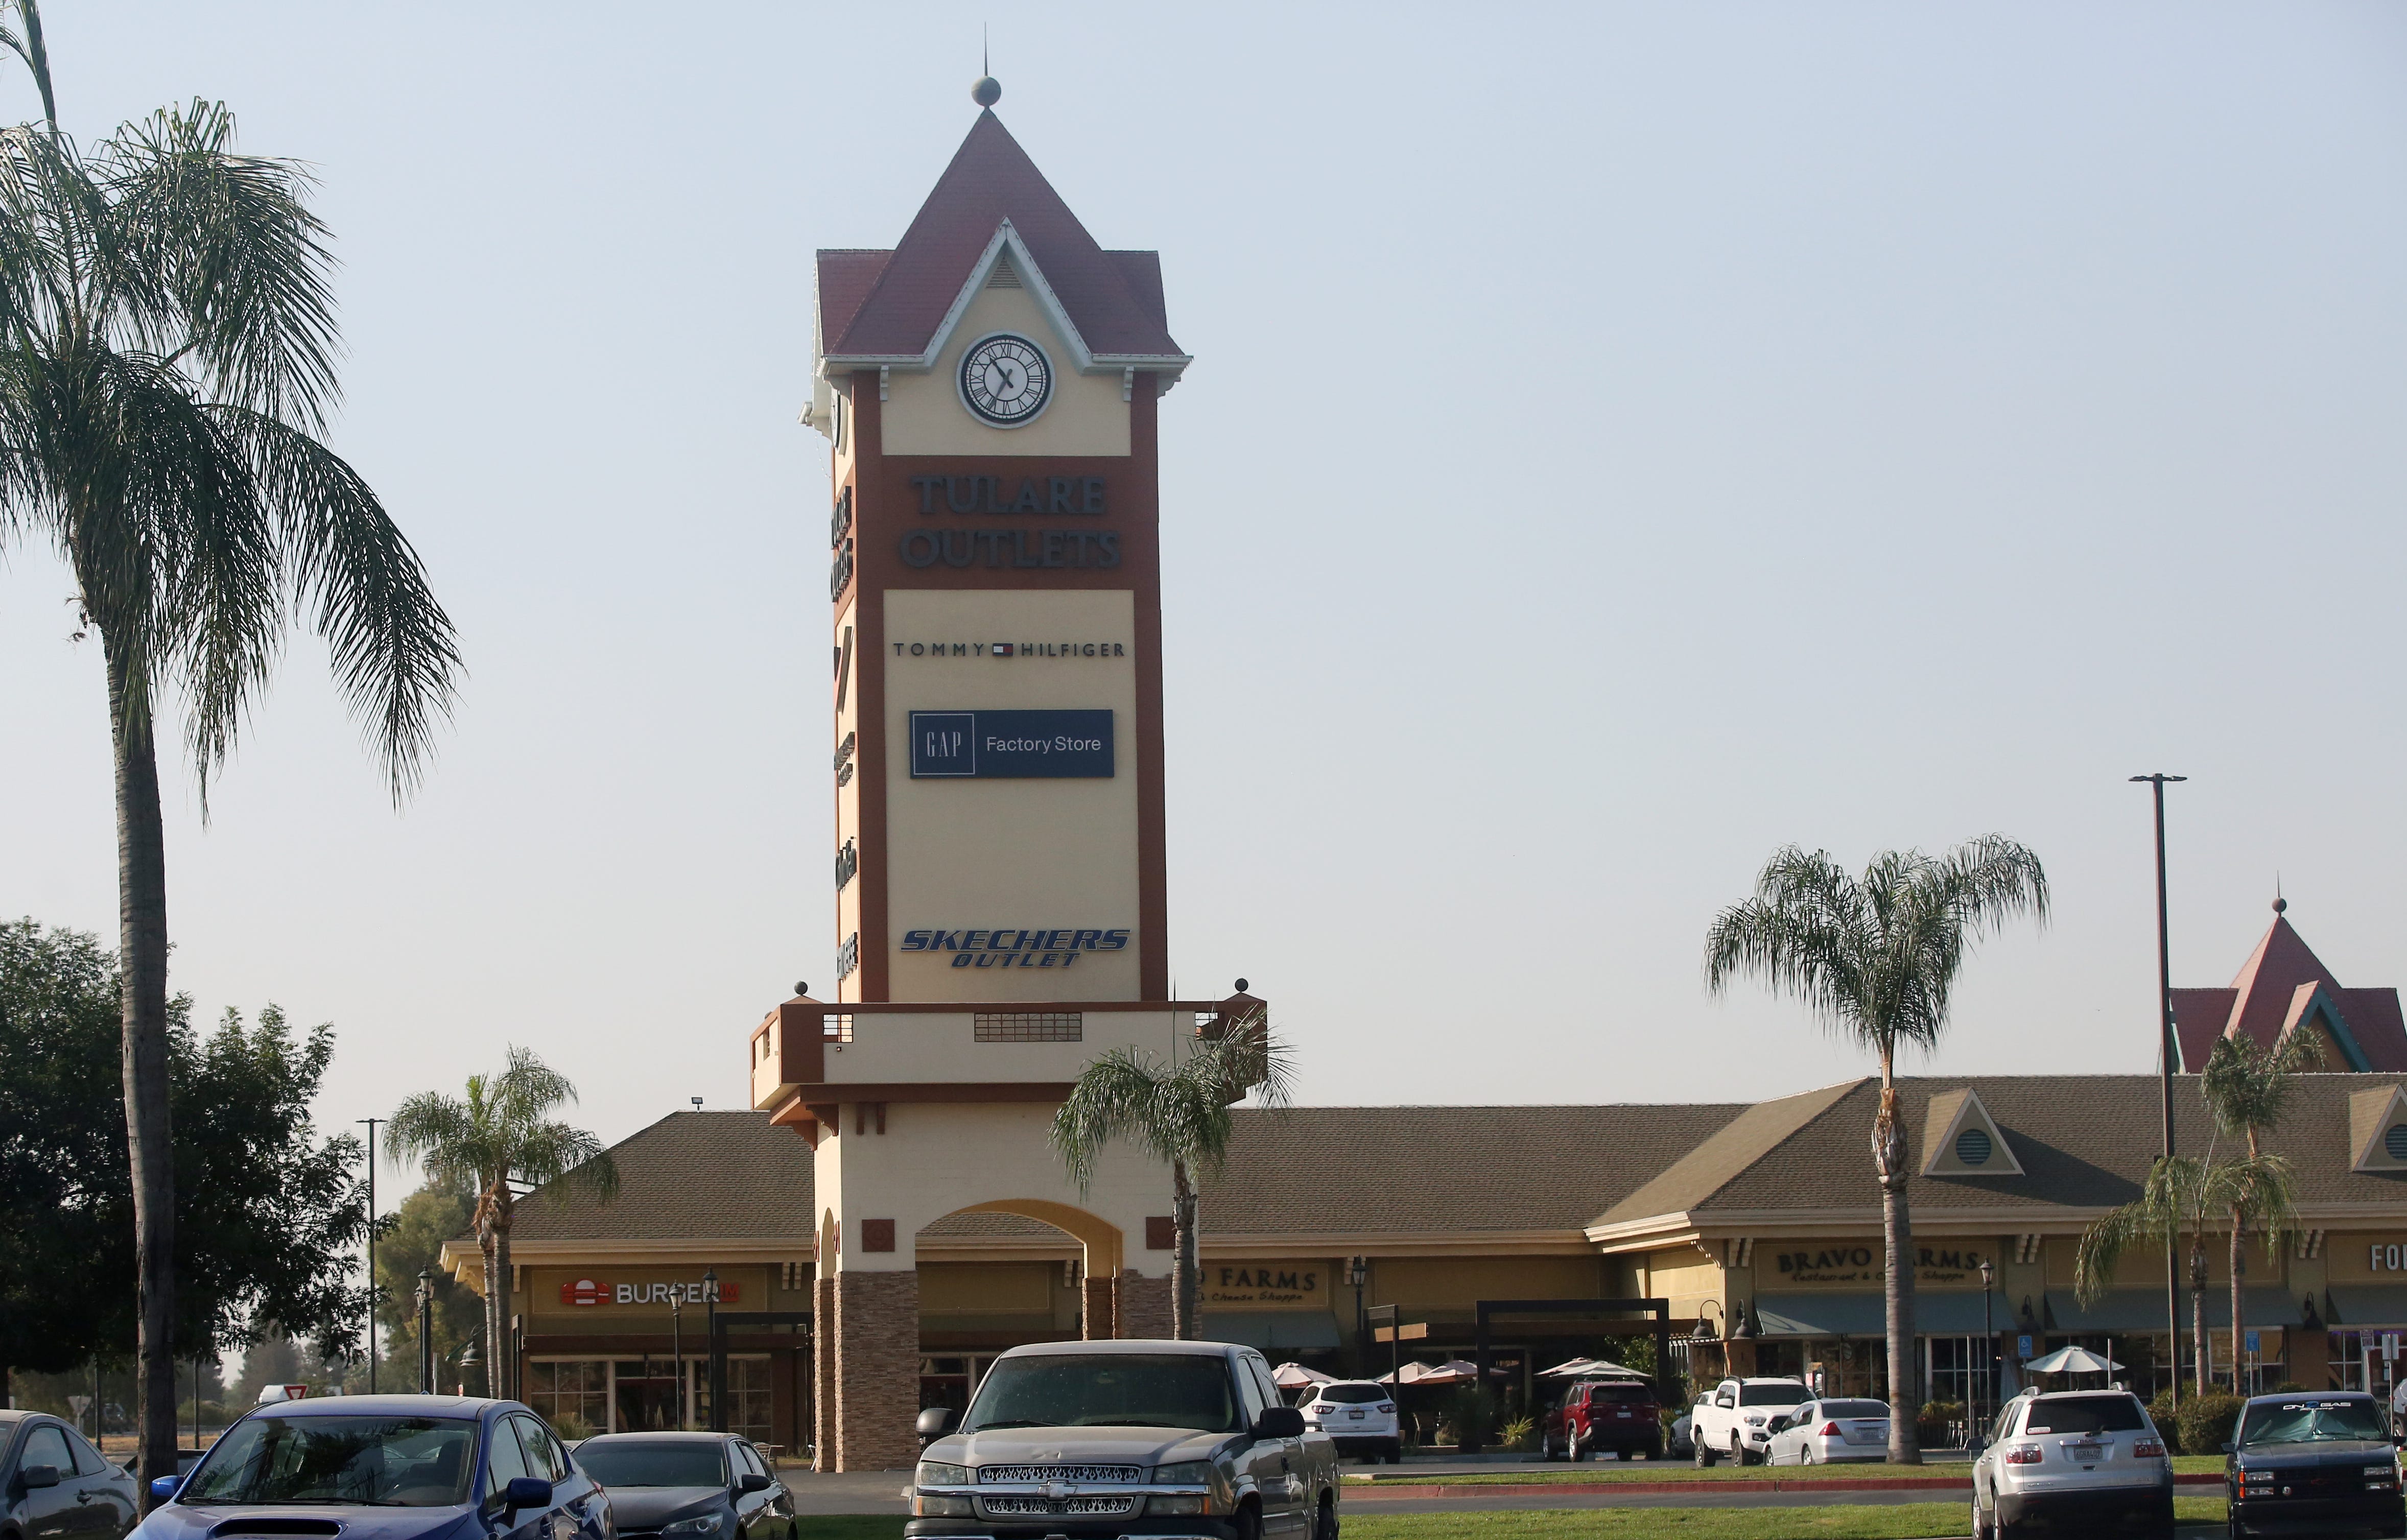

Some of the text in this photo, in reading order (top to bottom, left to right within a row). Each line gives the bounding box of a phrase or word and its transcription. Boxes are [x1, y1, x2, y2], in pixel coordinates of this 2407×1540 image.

[910, 475, 1106, 514] TULARE
[900, 529, 1121, 568] OUTLETS
[893, 643, 1124, 657] TOMMY HILFIGER
[927, 731, 961, 757] GAP
[986, 736, 1101, 754] Factory Store
[900, 929, 1131, 952] SKECHERS
[951, 952, 1080, 968] OUTLET
[1777, 1247, 1978, 1273] BRAVO RMS
[2371, 1244, 2407, 1271] FO
[1220, 1267, 1316, 1291] FARMS
[1212, 1292, 1254, 1302] Cheese
[1259, 1291, 1303, 1302] Shoppe
